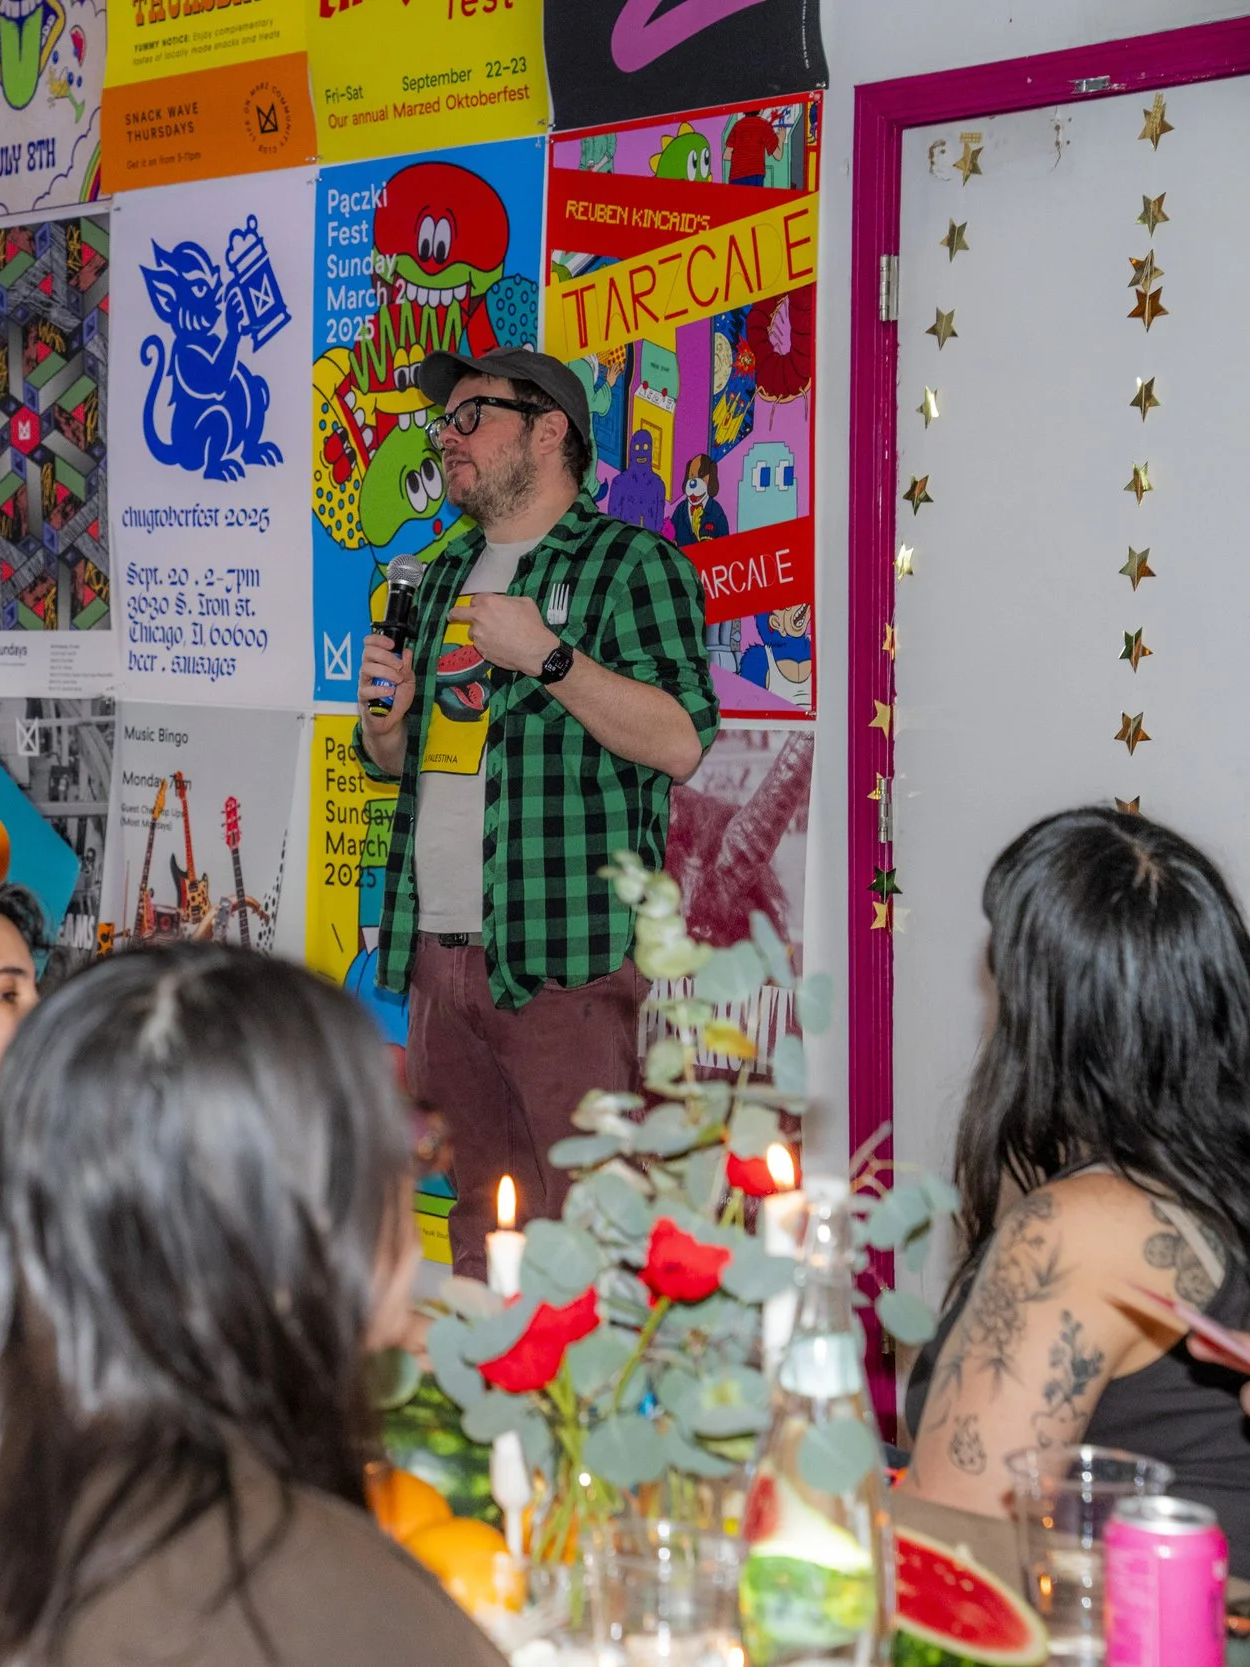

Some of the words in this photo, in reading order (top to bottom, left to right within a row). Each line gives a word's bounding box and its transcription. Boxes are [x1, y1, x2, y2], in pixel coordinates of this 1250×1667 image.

[402, 68, 472, 93] September
[125, 108, 162, 126] SNACK
[167, 101, 198, 118] WAVE
[328, 113, 348, 129] Our
[352, 105, 388, 126] annual
[393, 99, 440, 119] Marzed
[446, 84, 530, 111] Oktoberfest
[127, 121, 194, 143] THURSDAYS
[27, 137, 55, 171] 8TH
[327, 181, 388, 218] Pączki
[565, 200, 628, 226] REUBEN
[631, 206, 711, 234] KINCAID'S
[327, 220, 369, 247] Fest
[326, 249, 397, 280] Sunday
[327, 281, 388, 312] March
[395, 278, 406, 305] 2
[326, 314, 375, 344] 2025
[122, 503, 220, 534] chugtoberfest
[126, 561, 163, 593] Sept.
[168, 567, 189, 586] 20
[127, 592, 169, 620] 3630
[198, 592, 230, 616] Iron
[210, 621, 268, 654] 60609
[128, 650, 158, 672] beer
[171, 655, 237, 683] sausages
[124, 725, 155, 742] Music
[158, 727, 189, 747] Bingo
[325, 737, 357, 766] Pąc
[326, 768, 364, 793] Fest
[325, 799, 395, 833] Sunday
[326, 830, 388, 858] March
[324, 862, 377, 888] 2025
